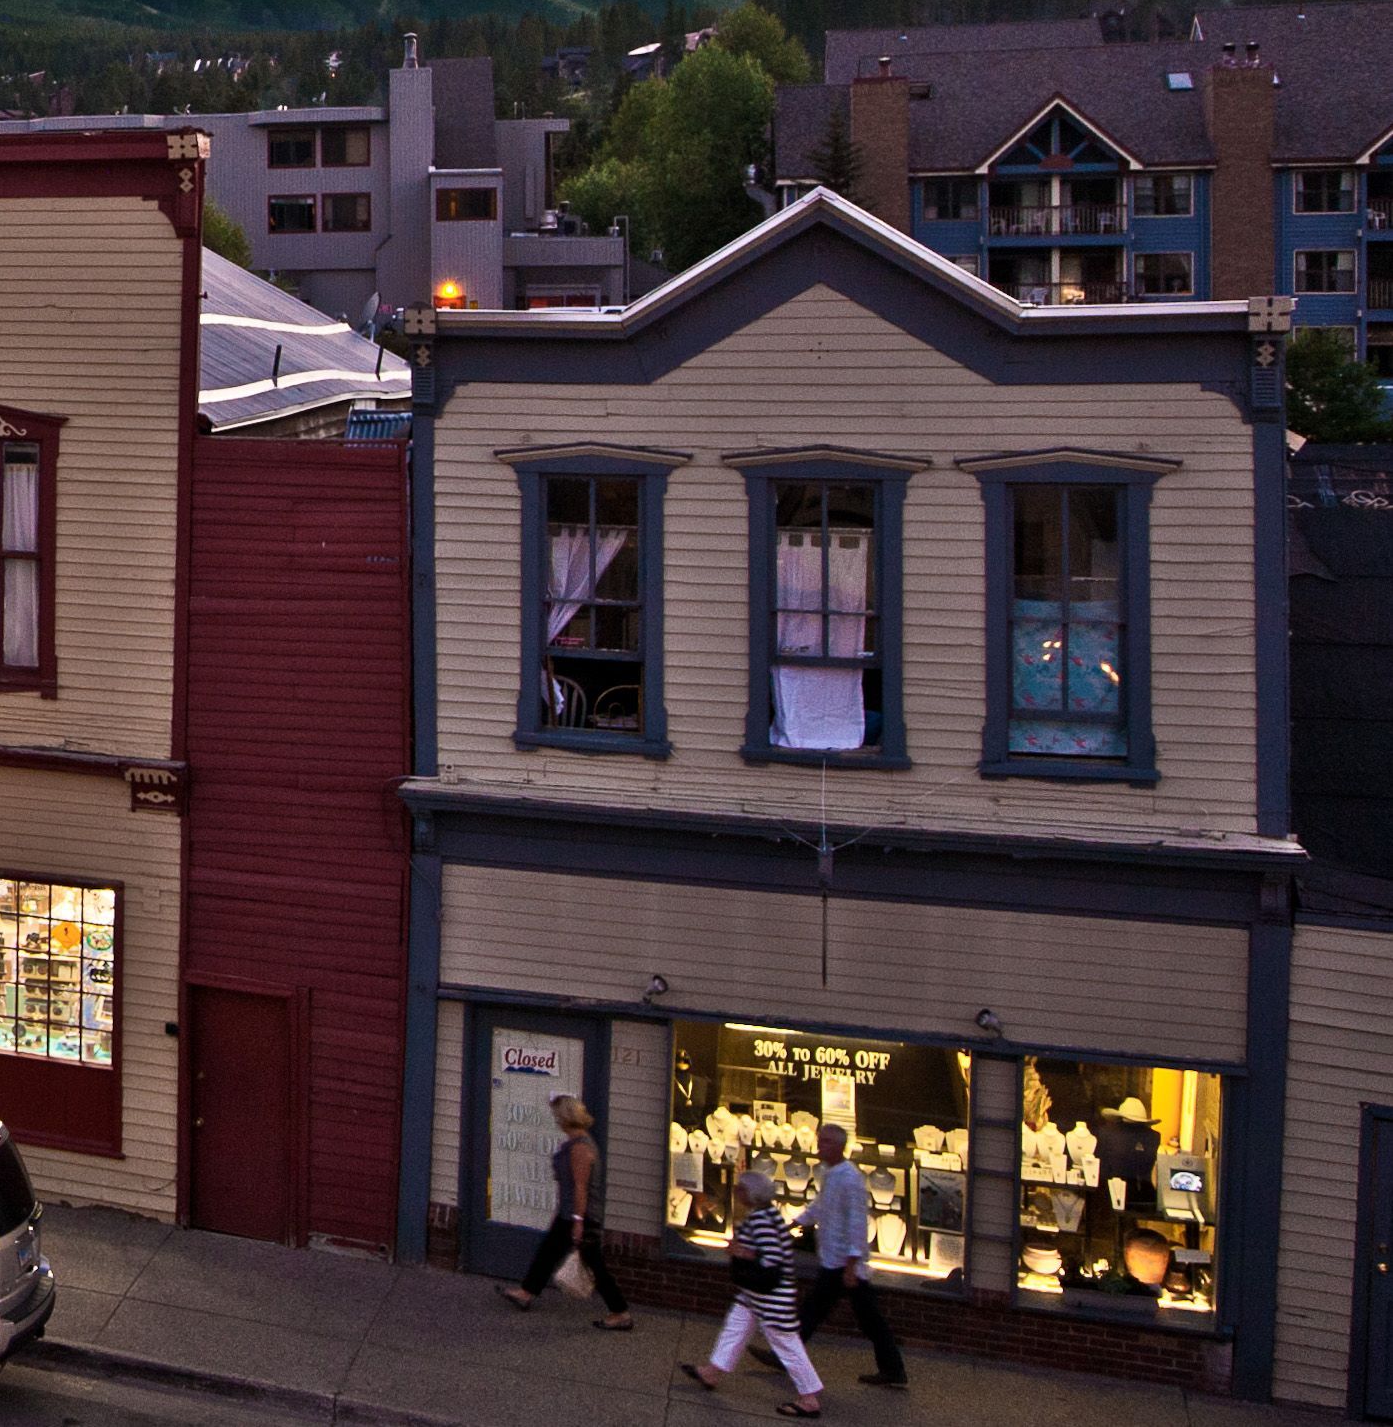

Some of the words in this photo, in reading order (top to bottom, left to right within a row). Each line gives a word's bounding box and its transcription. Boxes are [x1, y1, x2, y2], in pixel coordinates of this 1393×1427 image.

[504, 1048, 557, 1070] Closed
[754, 1039, 788, 1059] 30%
[793, 1047, 811, 1062] TO
[815, 1046, 850, 1066] 60%
[855, 1050, 891, 1070] OFF
[767, 1060, 797, 1076] ALL
[802, 1064, 876, 1085] JEWELRY
